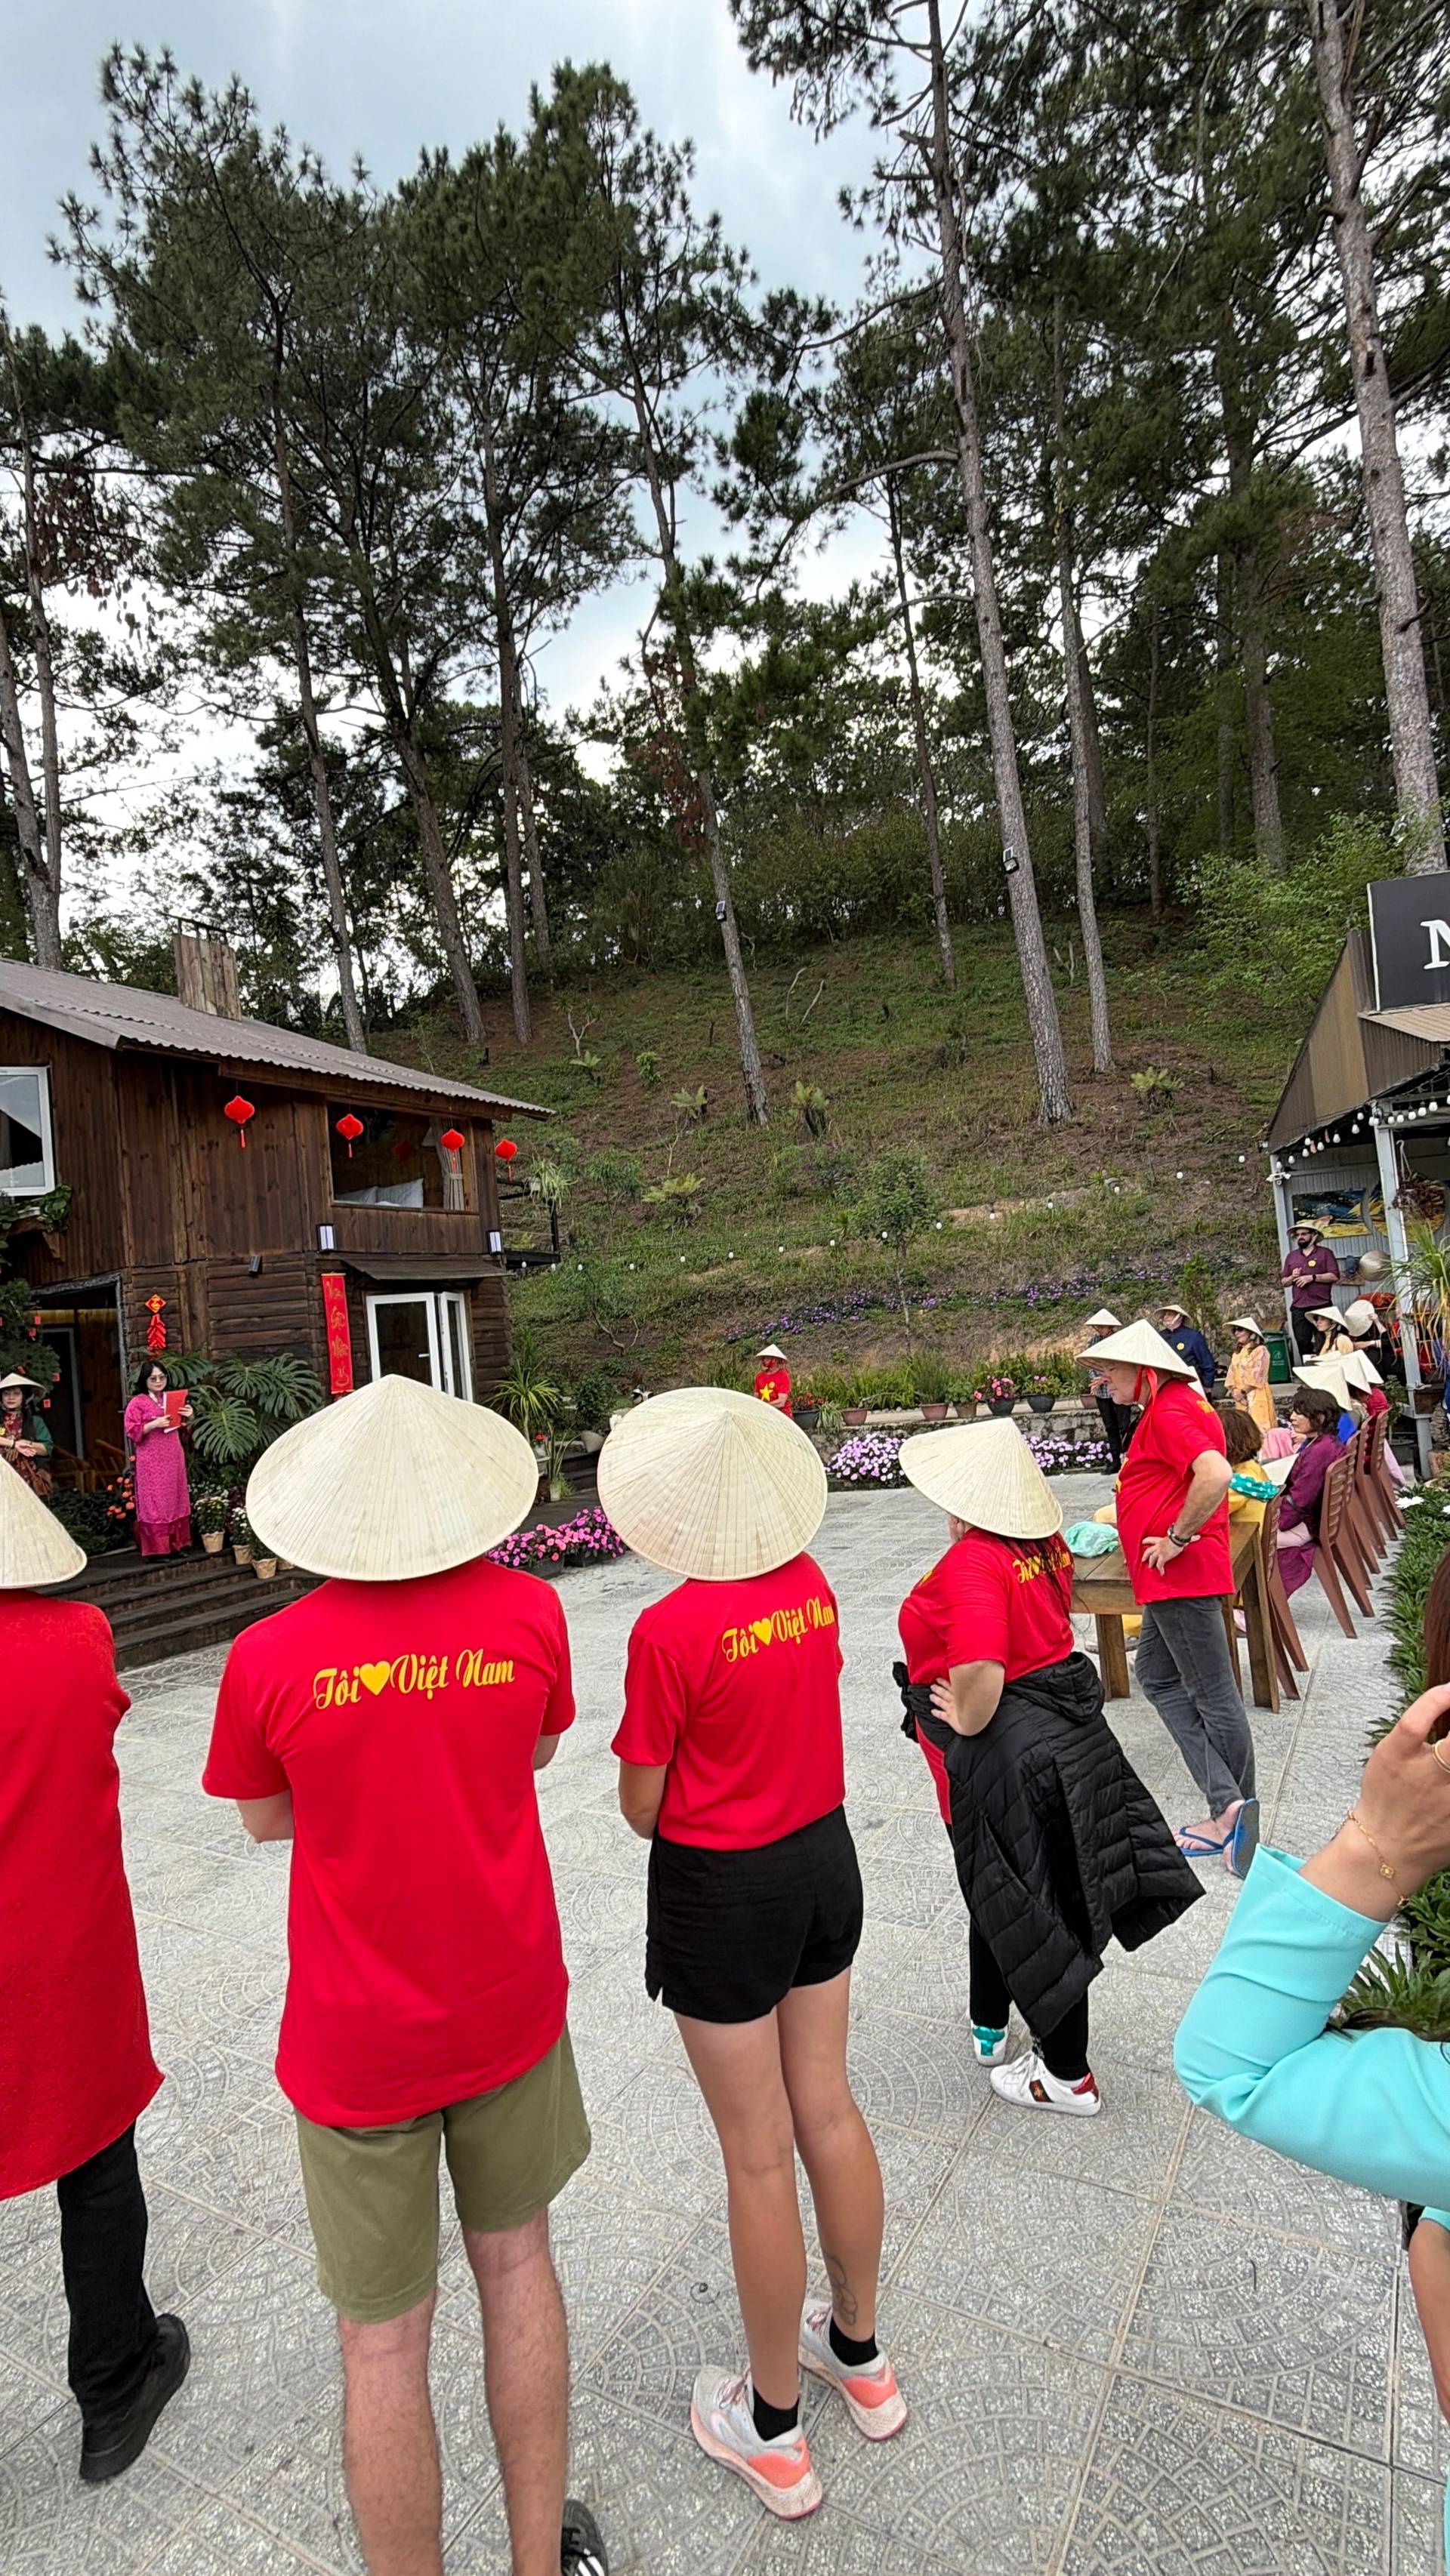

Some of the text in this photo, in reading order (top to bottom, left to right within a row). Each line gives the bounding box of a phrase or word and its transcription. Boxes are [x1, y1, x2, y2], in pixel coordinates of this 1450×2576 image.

[722, 1624, 759, 1662] Tôi
[770, 1607, 808, 1644] Việt
[313, 1648, 515, 1709] Tôi Việt Nam
